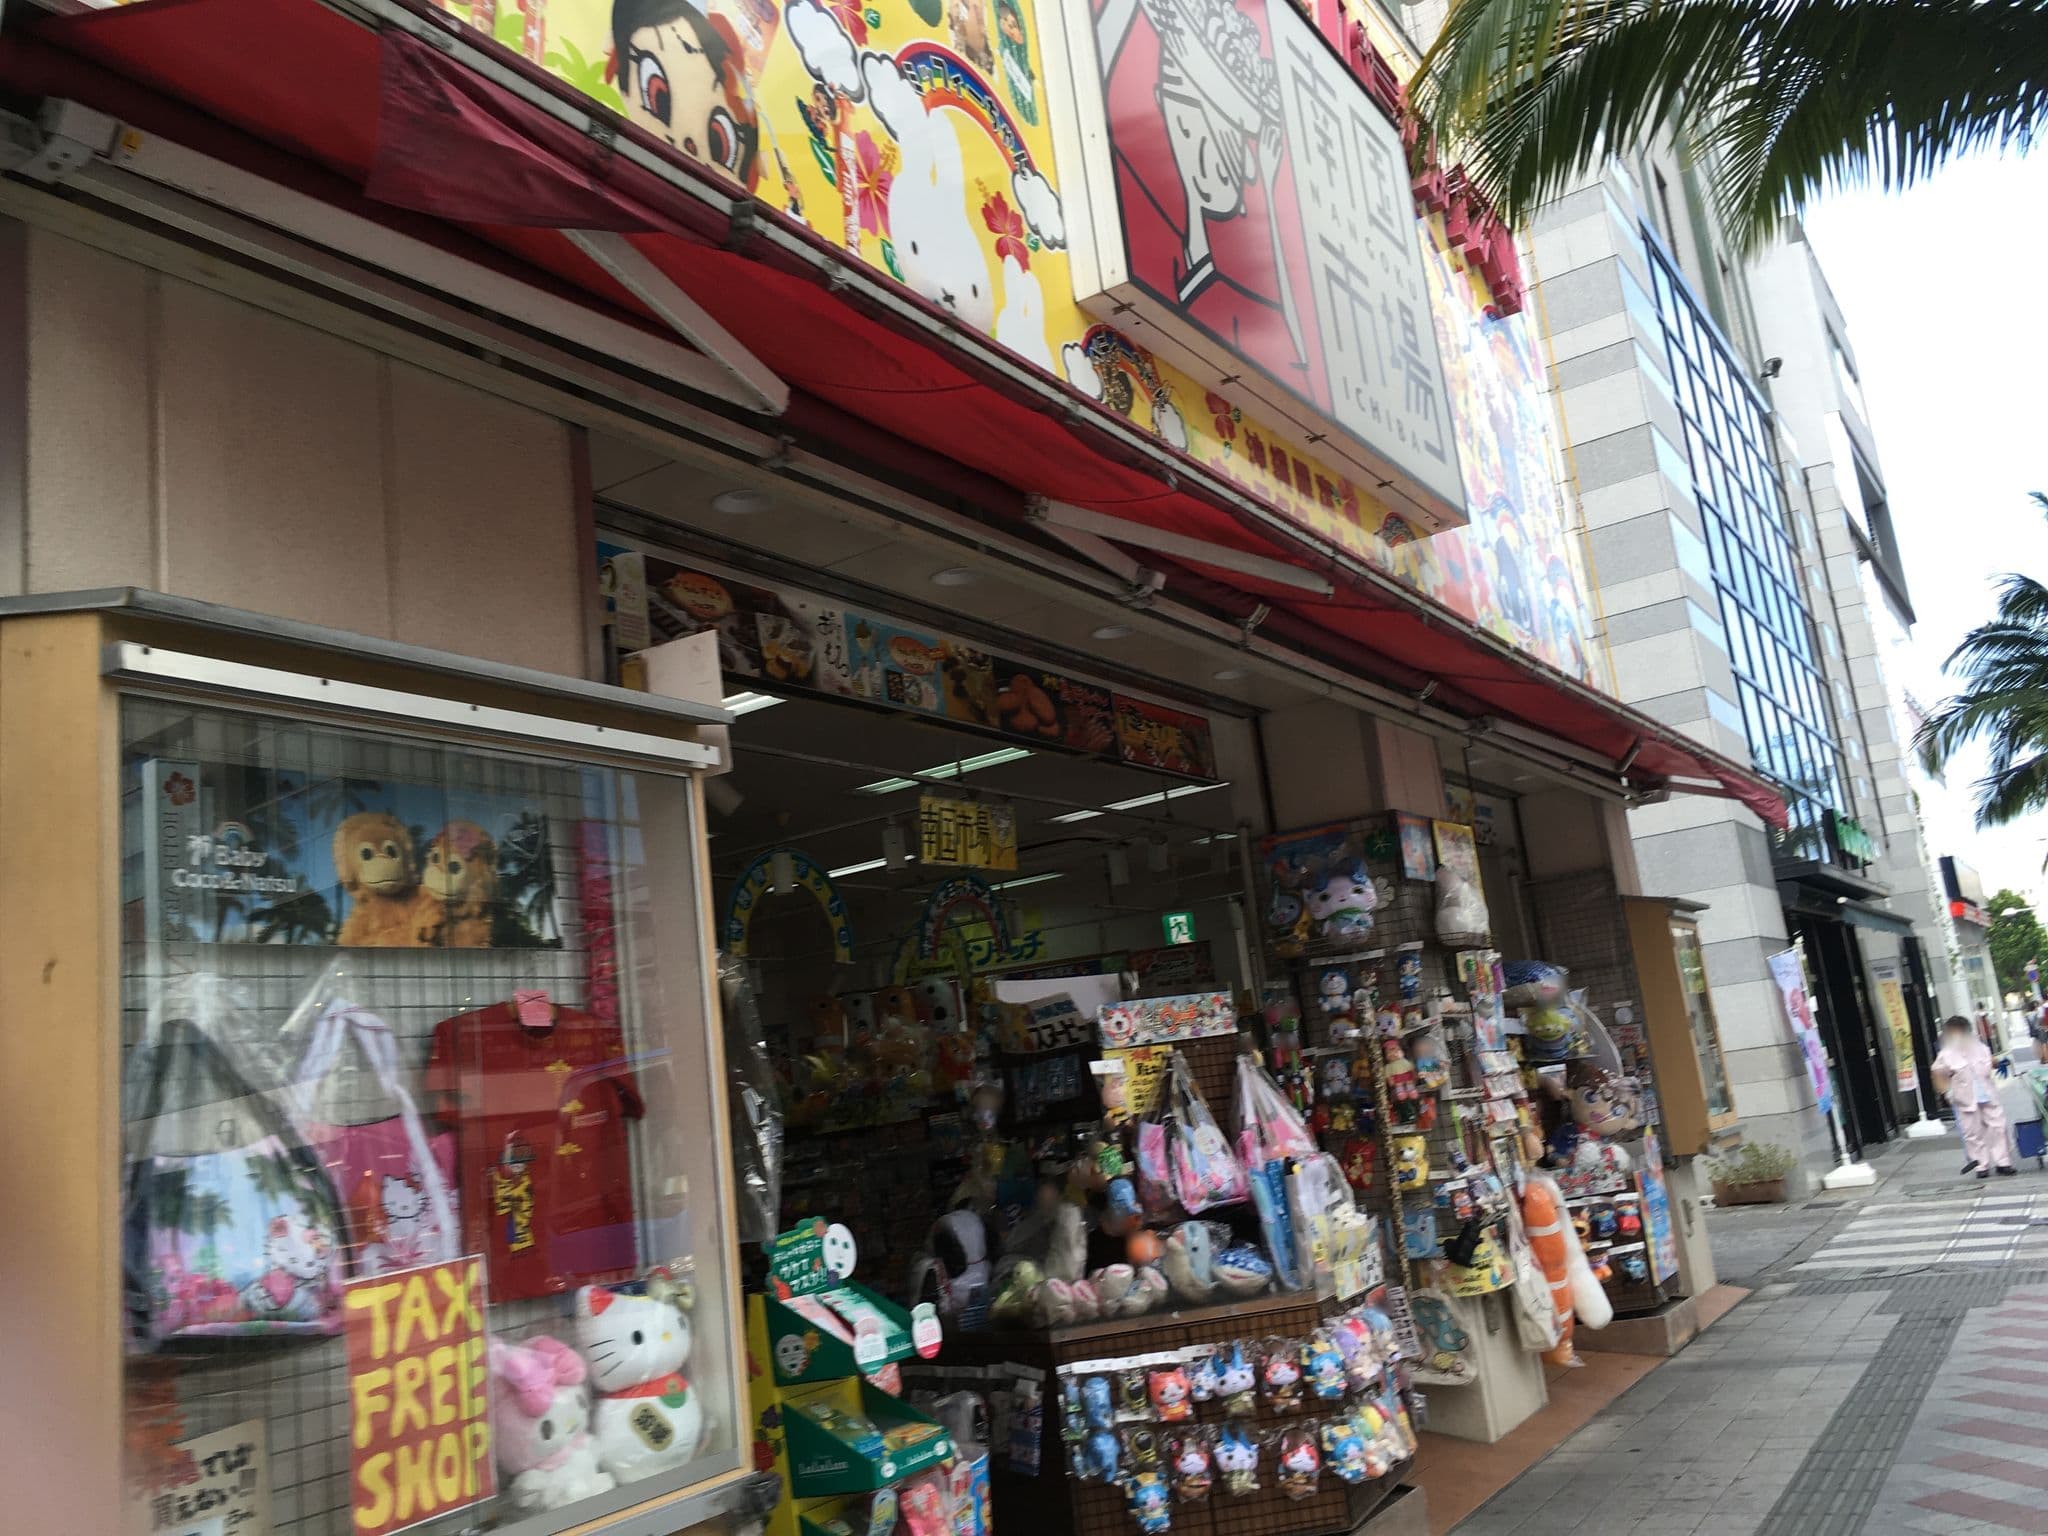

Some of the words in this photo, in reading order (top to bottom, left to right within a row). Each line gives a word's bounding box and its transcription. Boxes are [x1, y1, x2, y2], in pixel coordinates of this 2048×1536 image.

[1342, 376, 1420, 454] ICHIBA
[215, 844, 269, 868] Baby
[920, 804, 992, 865] 南国市場
[346, 1263, 483, 1360] TAX
[354, 1337, 487, 1449] FREE
[354, 1421, 490, 1529] SHOP
